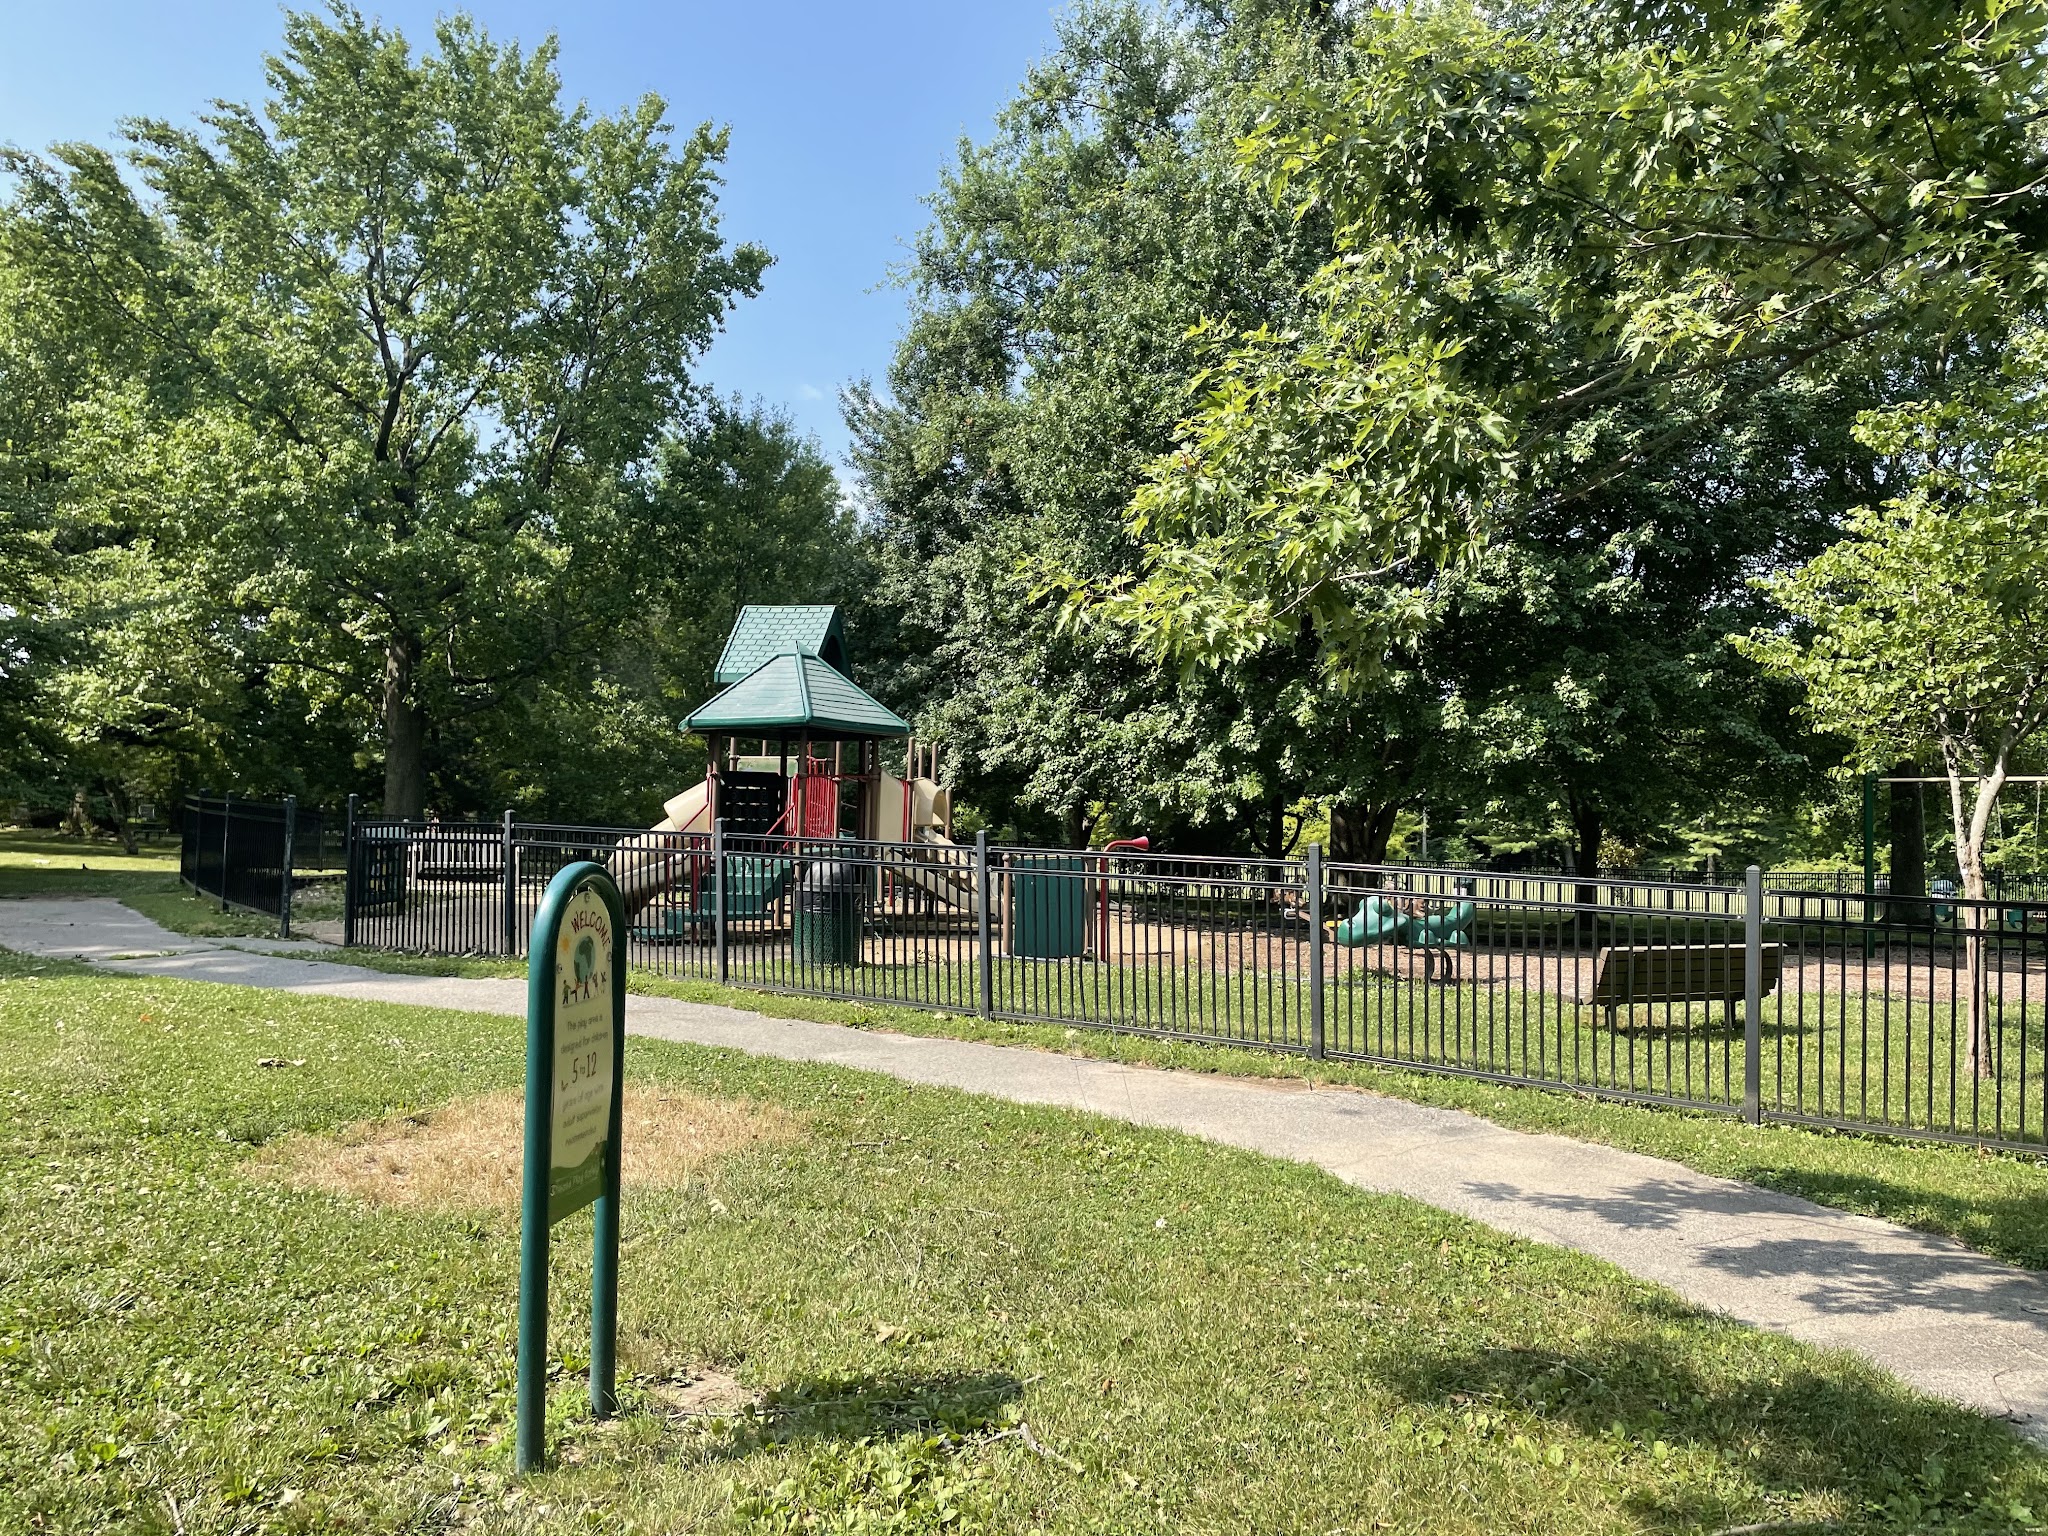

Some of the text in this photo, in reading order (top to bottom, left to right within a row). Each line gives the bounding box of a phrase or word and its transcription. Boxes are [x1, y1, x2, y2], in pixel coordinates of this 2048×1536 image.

[571, 910, 611, 949] WELCOME
[567, 1020, 577, 1031] The
[582, 1035, 591, 1046] for
[572, 1057, 579, 1084] 5
[586, 1051, 597, 1078] 12
